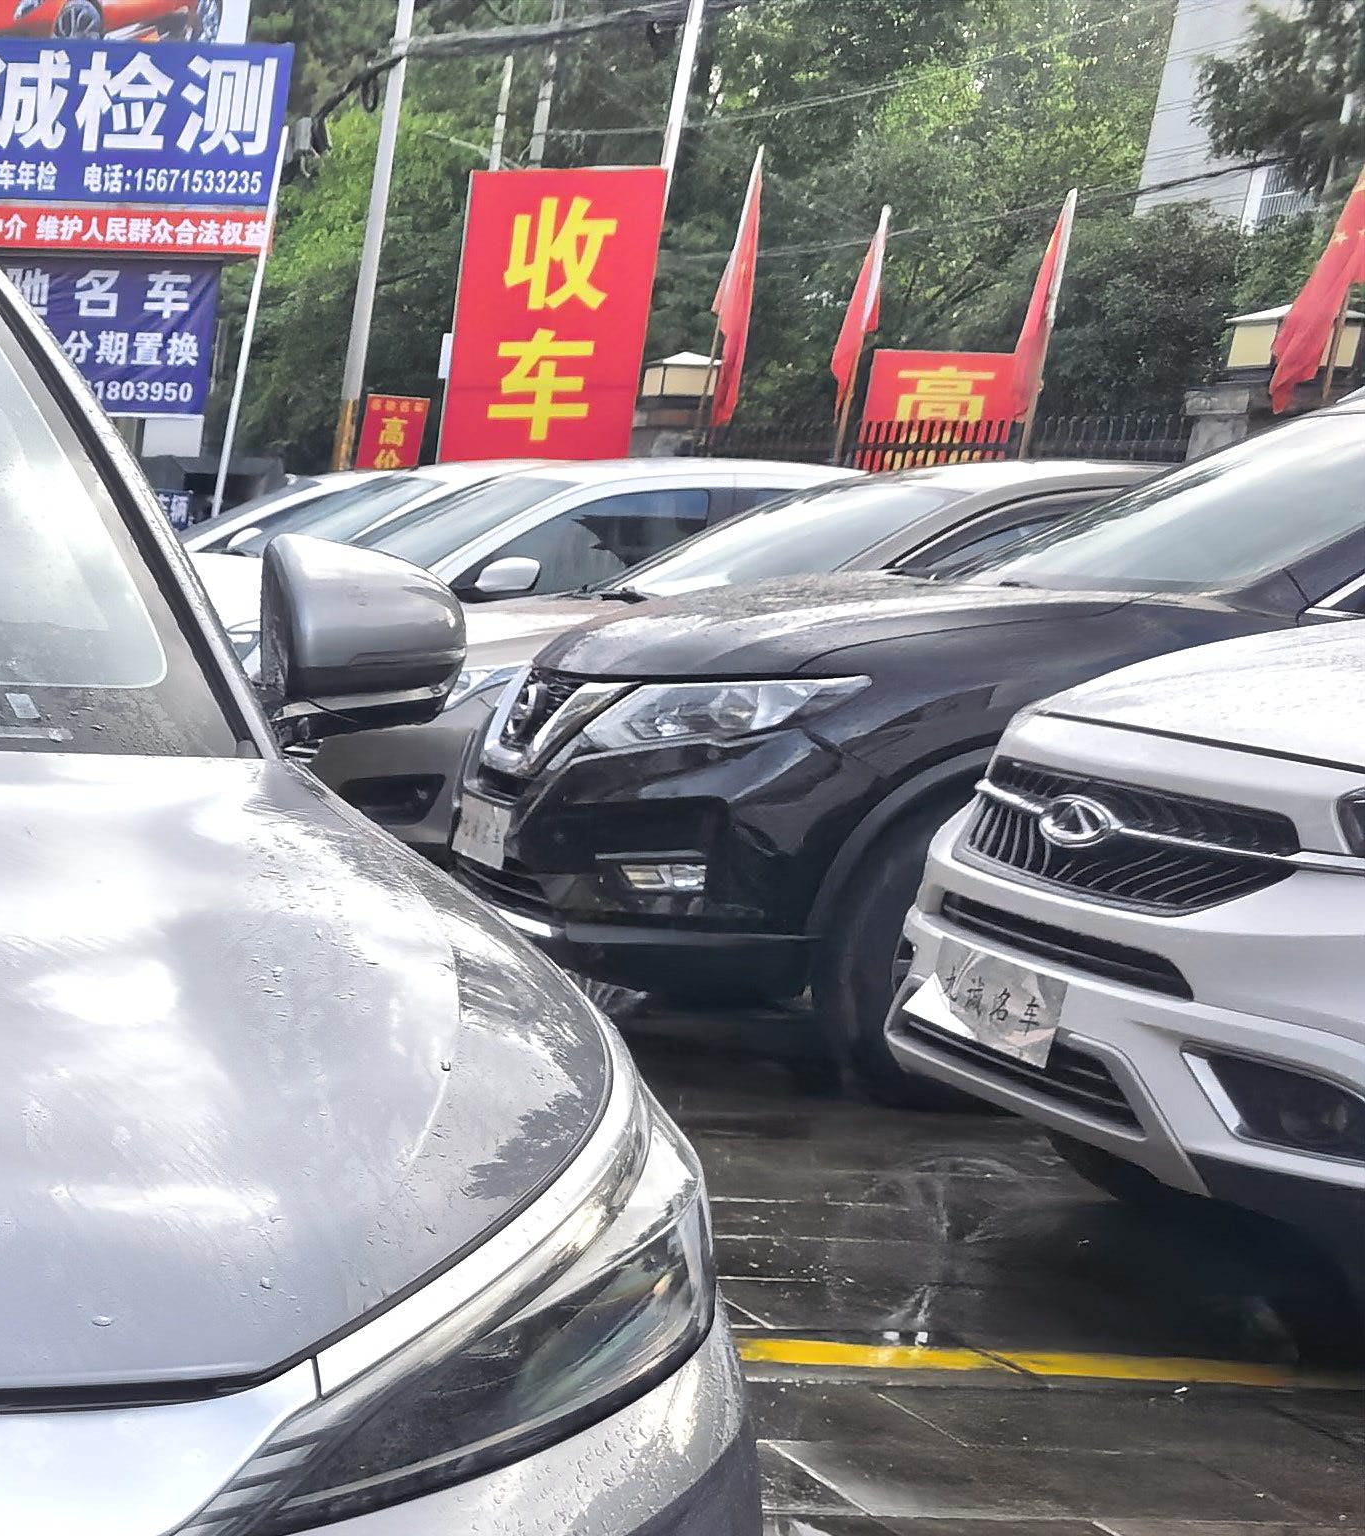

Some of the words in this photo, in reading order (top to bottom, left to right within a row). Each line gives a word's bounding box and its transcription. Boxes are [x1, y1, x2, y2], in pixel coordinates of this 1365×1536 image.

[35, 214, 269, 247] 维护人民群众合法权益
[486, 196, 618, 442] 收车
[62, 330, 200, 367] 分期置换
[87, 381, 194, 402] 1803950
